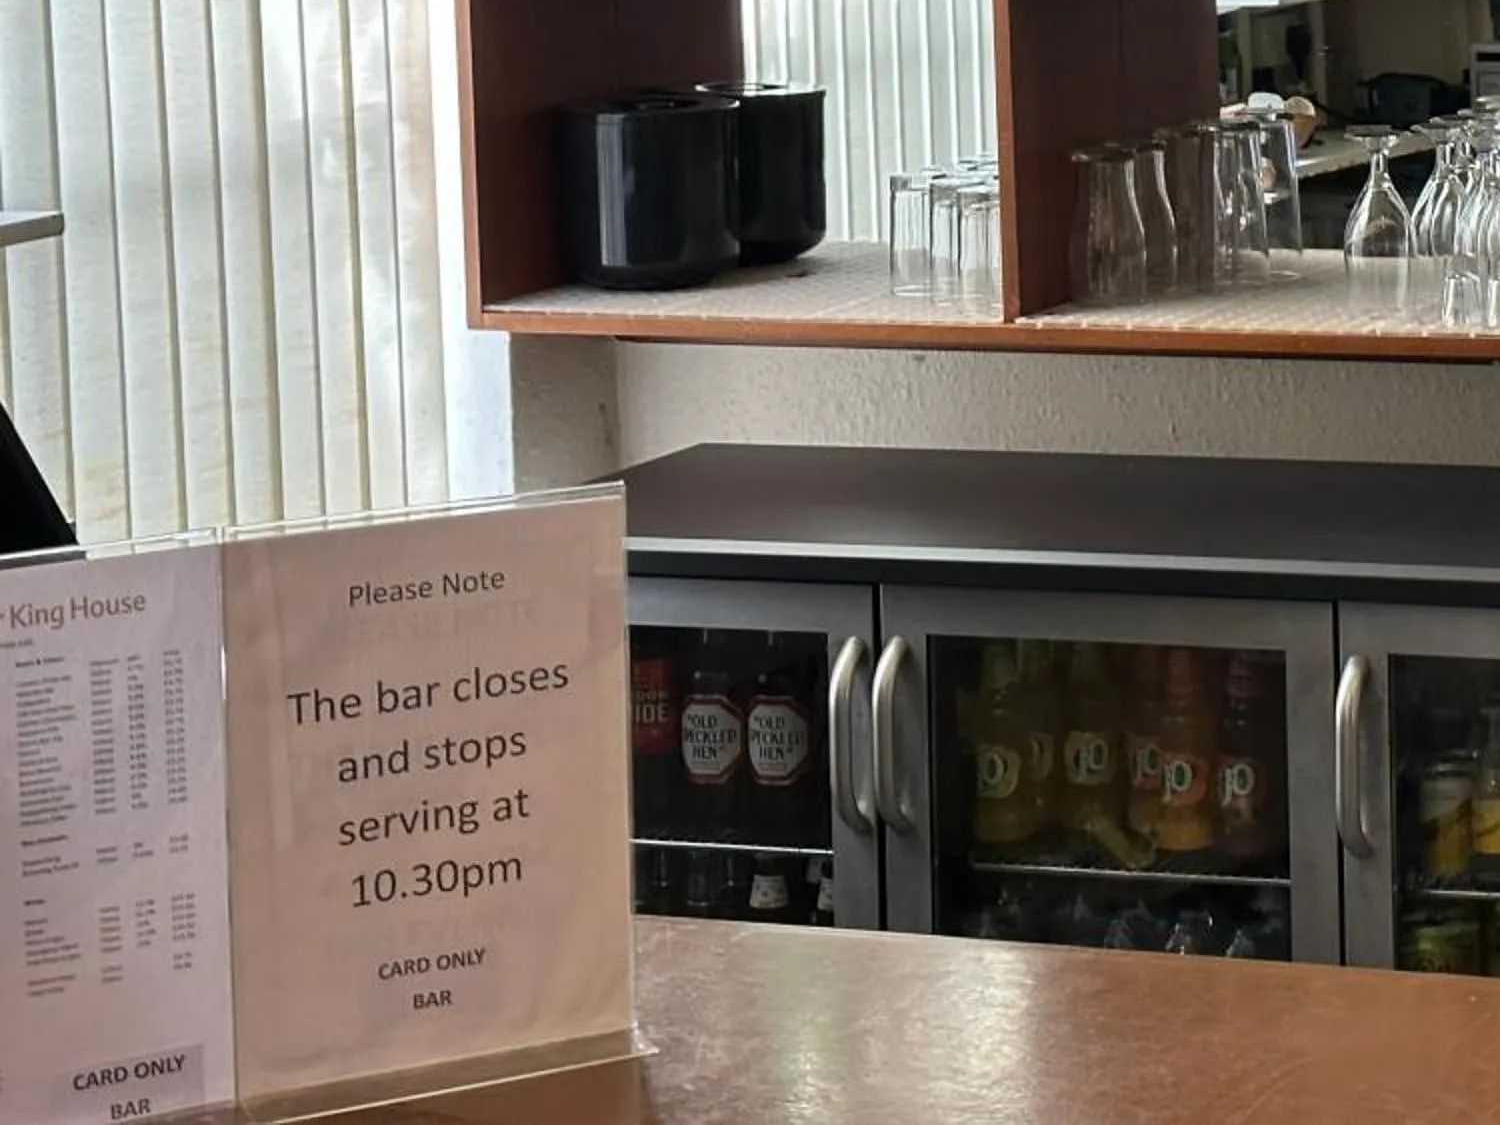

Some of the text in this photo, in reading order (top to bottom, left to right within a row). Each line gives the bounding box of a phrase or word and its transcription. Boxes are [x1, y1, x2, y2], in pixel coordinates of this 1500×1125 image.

[348, 571, 506, 607] Please Note
[9, 593, 147, 630] King House
[286, 663, 569, 725] The bar closes
[338, 730, 527, 783] and stops
[338, 789, 531, 847] serving at
[351, 856, 523, 908] 10.30pm
[377, 947, 486, 981] CARD ONLY
[412, 990, 453, 1010] BAR
[72, 1054, 187, 1092] CARD ONLY
[110, 1097, 151, 1121] BAR
